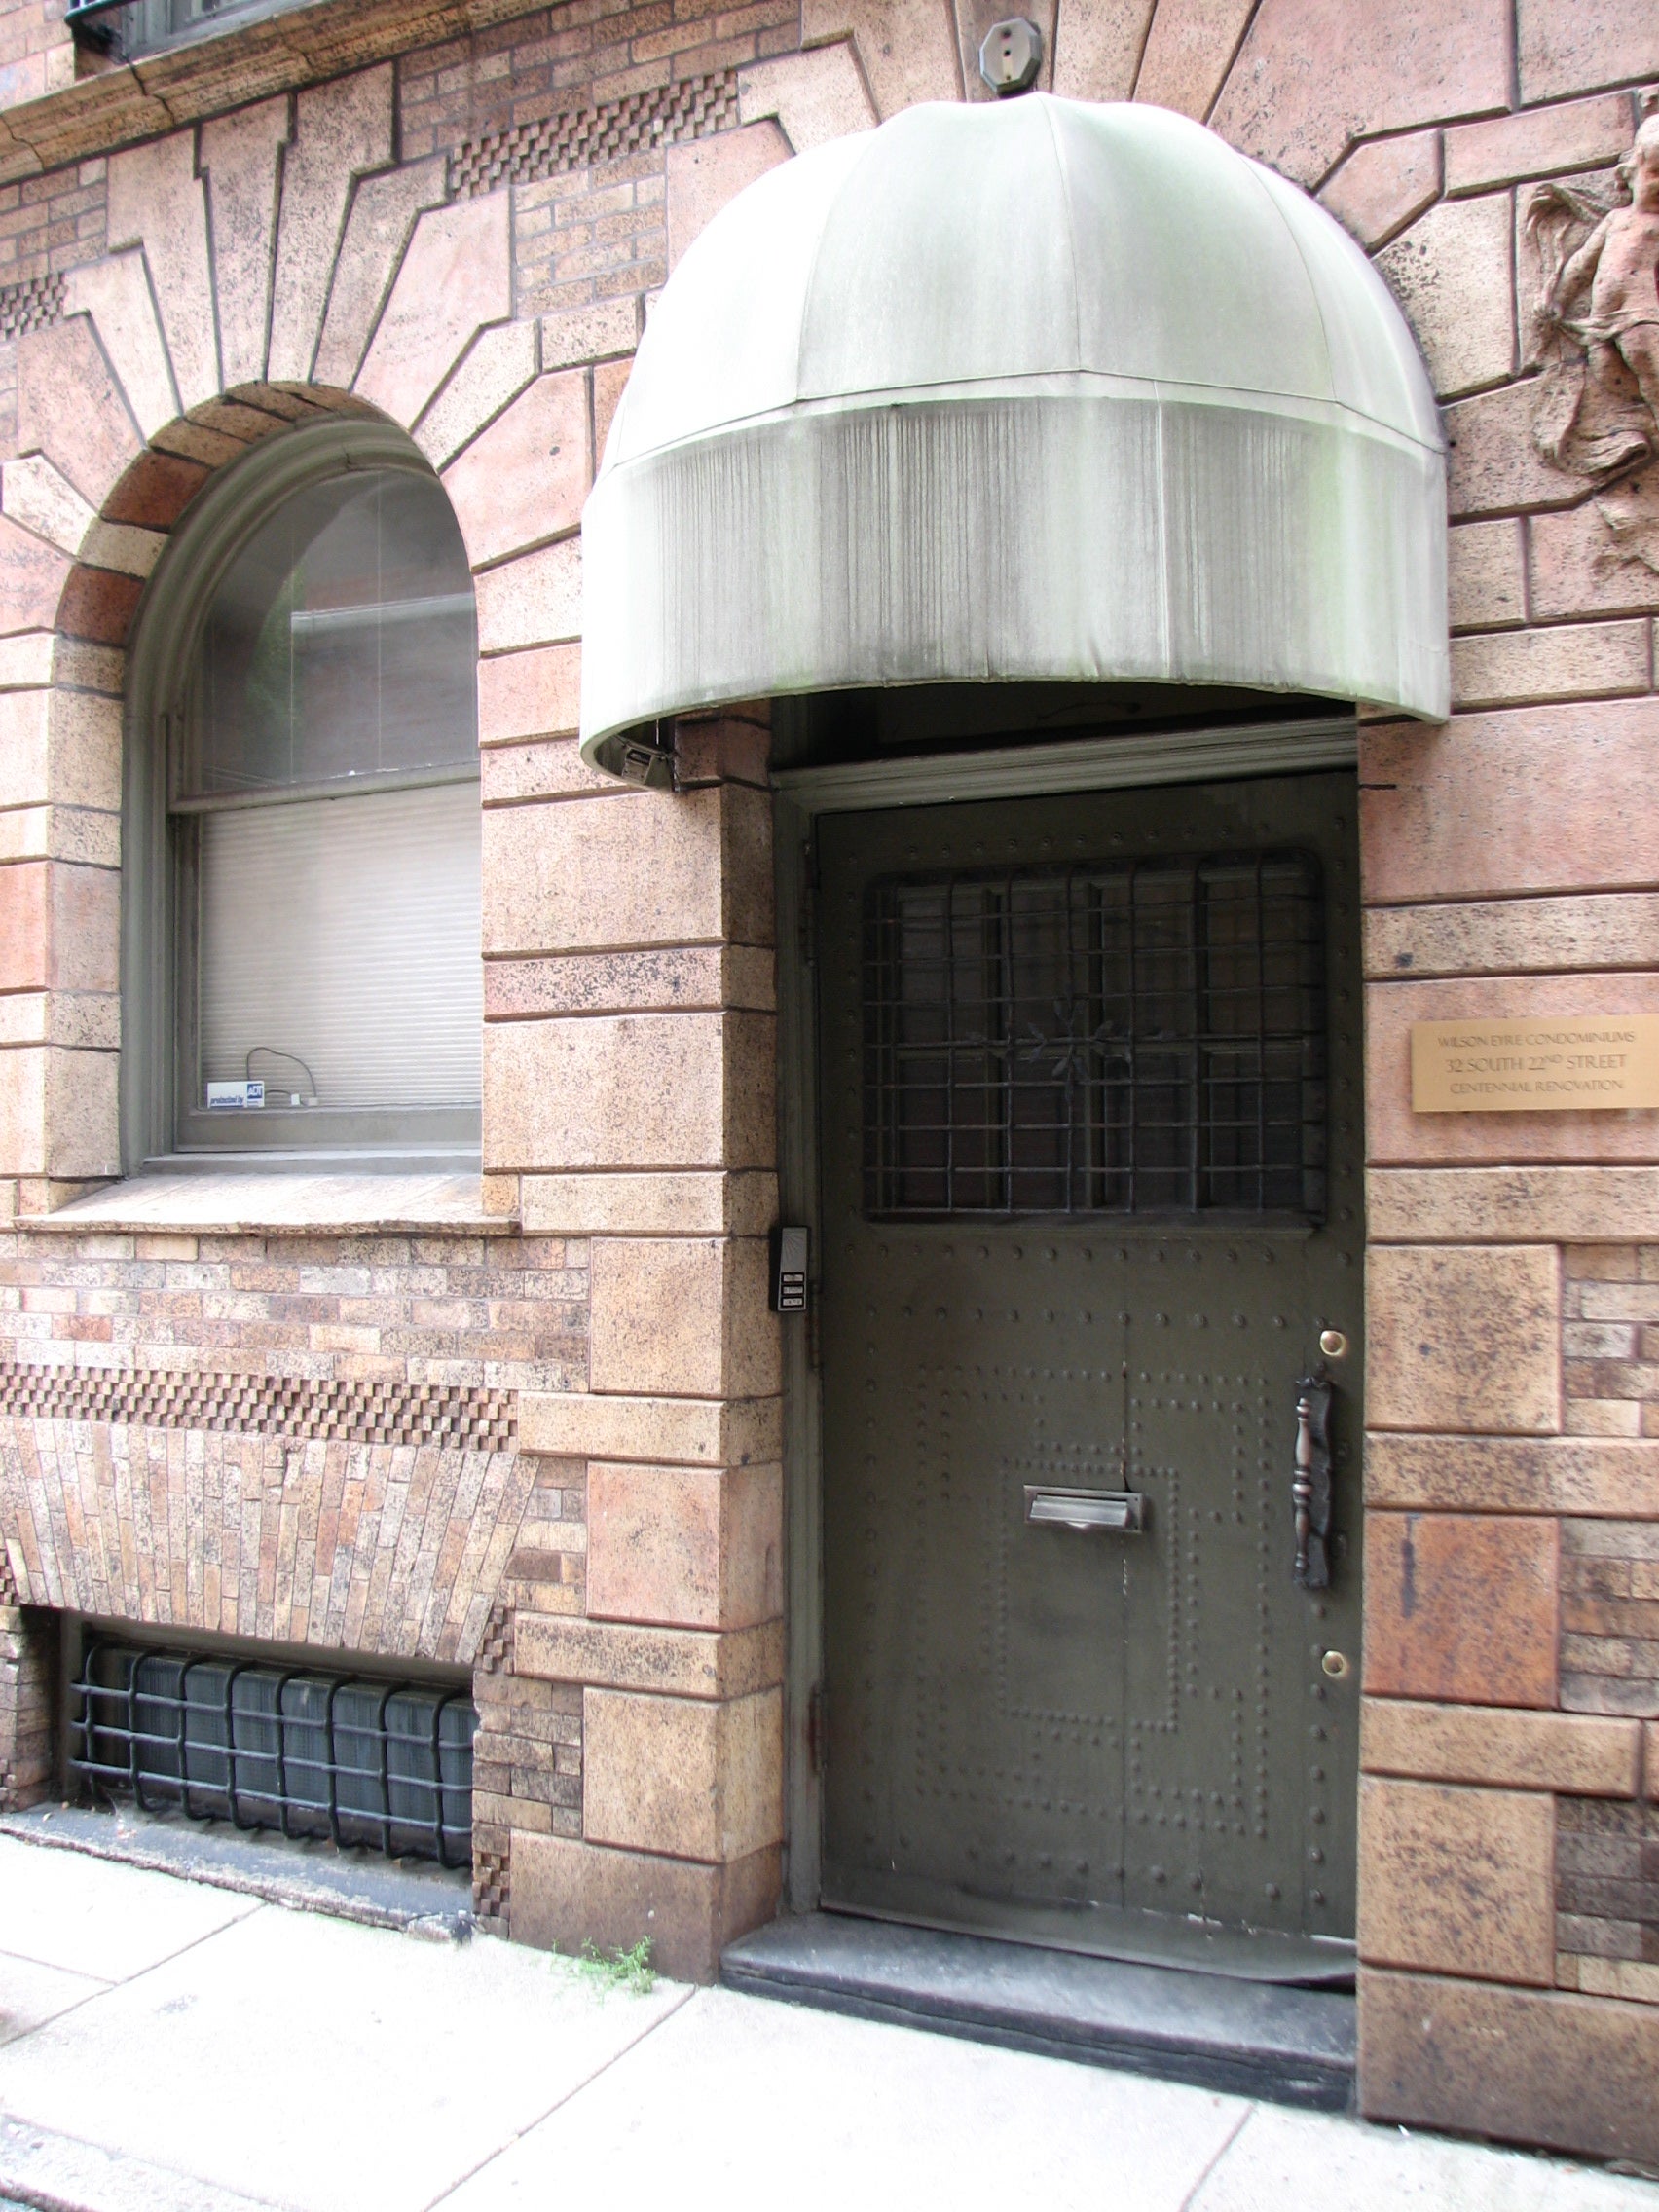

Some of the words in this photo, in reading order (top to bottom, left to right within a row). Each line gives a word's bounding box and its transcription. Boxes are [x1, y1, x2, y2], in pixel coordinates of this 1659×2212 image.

[1438, 1036, 1488, 1048] WILSON
[1491, 1034, 1525, 1046] EYRE
[1527, 1030, 1636, 1045] CONDOMINIUMS
[1446, 1059, 1463, 1073] 32
[1467, 1057, 1523, 1072] SOUTH
[1567, 1054, 1627, 1069] STREET
[248, 1085, 263, 1096] ADT
[1450, 1081, 1531, 1094] CENTENNIAL
[1536, 1079, 1623, 1092] RENOVATION
[210, 1095, 236, 1105] protected
[237, 1095, 243, 1105] by
